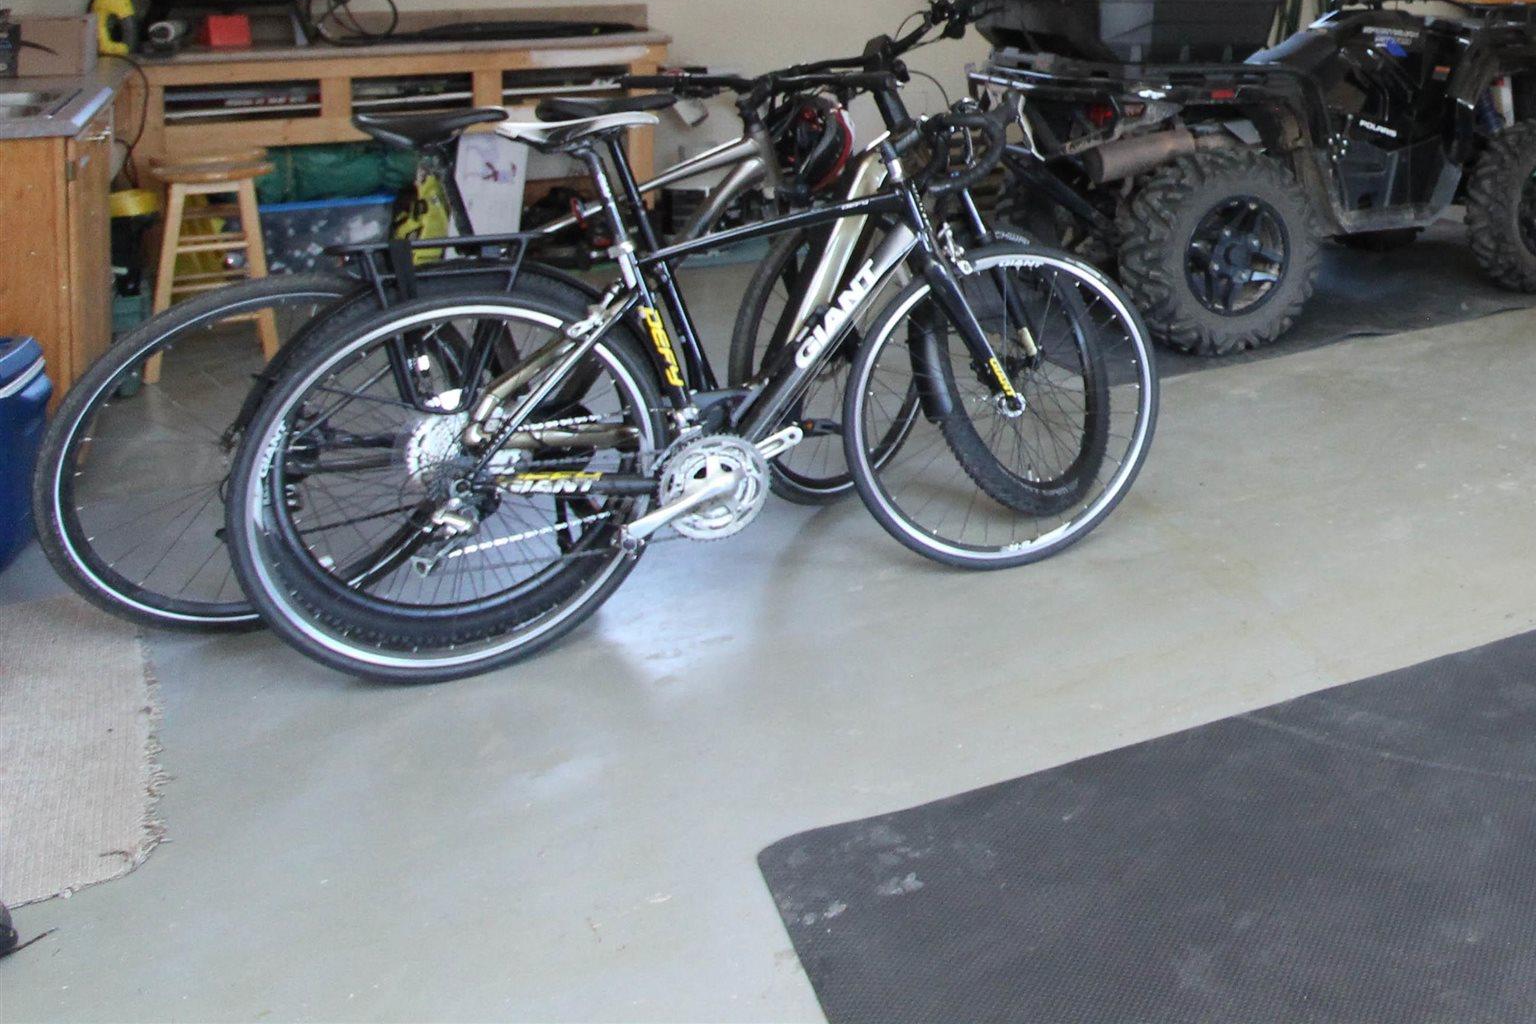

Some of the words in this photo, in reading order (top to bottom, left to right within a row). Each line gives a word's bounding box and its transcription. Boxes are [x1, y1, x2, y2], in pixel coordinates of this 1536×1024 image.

[1359, 119, 1398, 138] POLARIS
[998, 258, 1046, 269] GIANT
[794, 258, 876, 369] GIANT
[639, 307, 685, 387] DEFY
